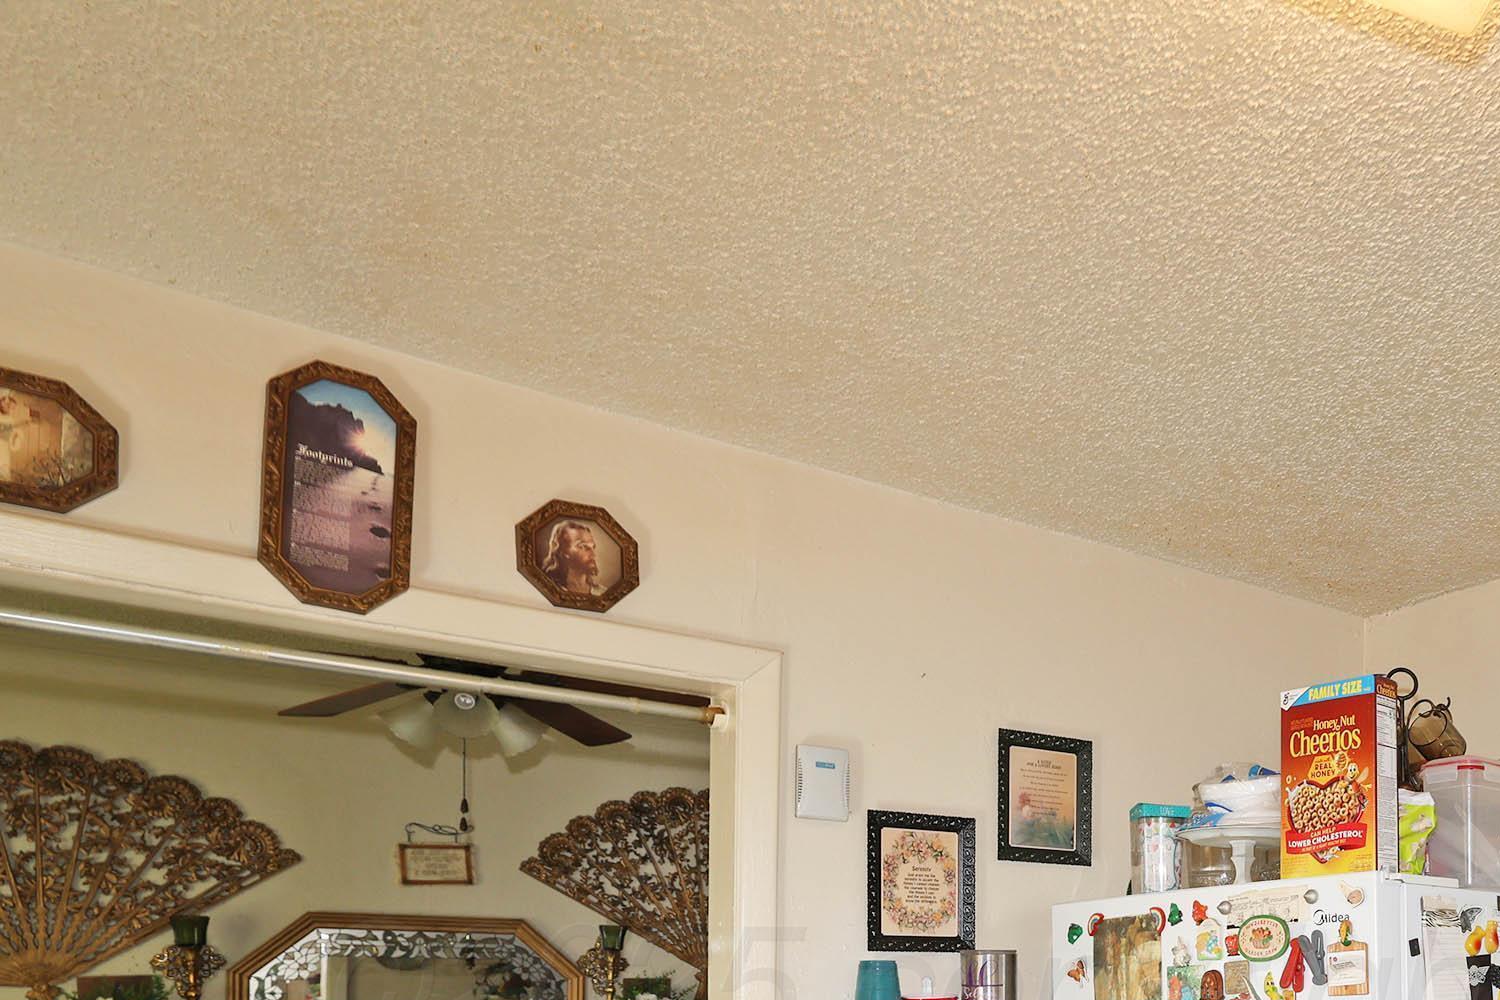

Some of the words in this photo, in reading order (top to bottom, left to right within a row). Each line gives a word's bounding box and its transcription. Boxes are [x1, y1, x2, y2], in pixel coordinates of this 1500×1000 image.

[295, 442, 354, 468] Footprints
[1309, 684, 1342, 701] FAMILY
[1341, 680, 1362, 694] SIZE
[1313, 719, 1340, 732] Honey
[1340, 714, 1356, 727] Nut
[1289, 729, 1361, 757] Cheerios
[1311, 770, 1336, 778] HONEY
[1315, 760, 1332, 772] REAL
[1288, 837, 1312, 848] LOWER
[1312, 830, 1363, 845] CHOLESTEROL
[1313, 909, 1350, 925] Midea
